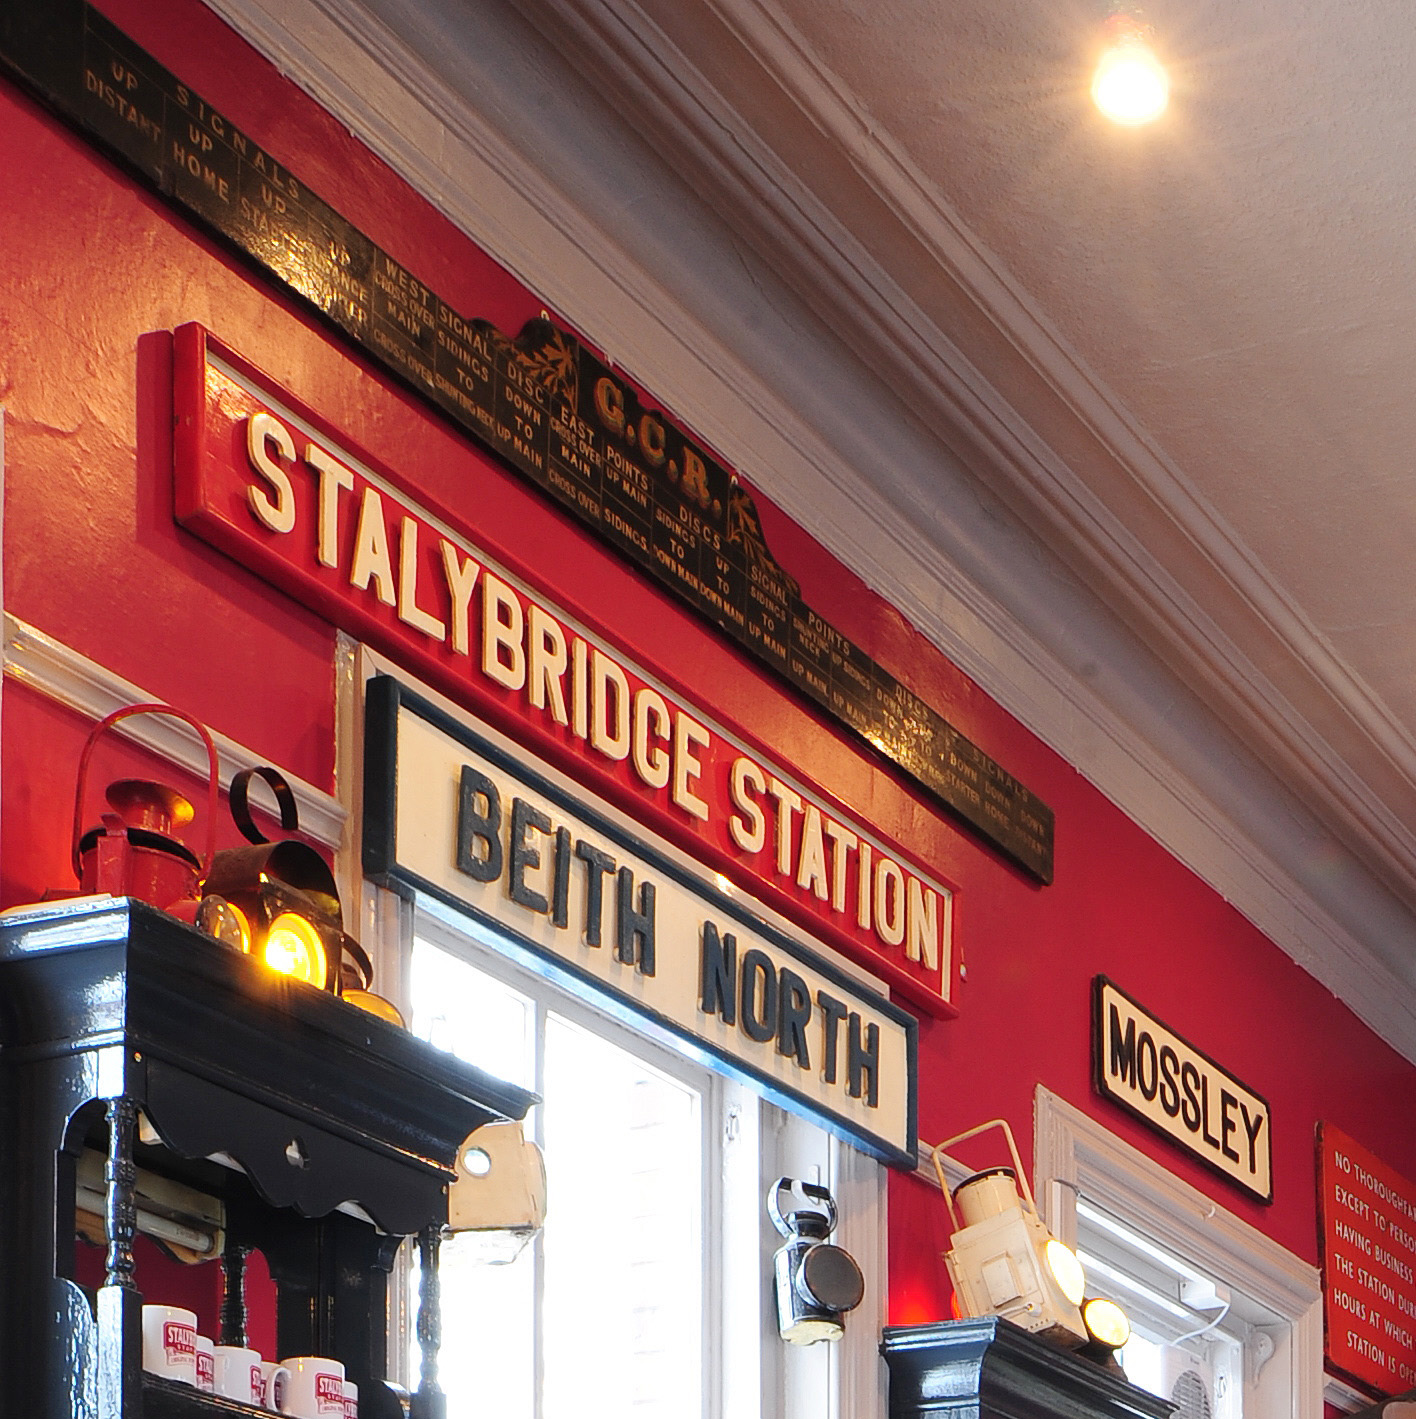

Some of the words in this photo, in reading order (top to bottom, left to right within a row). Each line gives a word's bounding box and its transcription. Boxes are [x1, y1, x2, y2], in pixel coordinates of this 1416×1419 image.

[111, 61, 139, 91] UP
[84, 68, 162, 143] DISTANT
[188, 123, 213, 152] UP
[173, 141, 230, 204] HOME
[261, 184, 287, 214] UP
[385, 258, 430, 306] WEST
[387, 301, 421, 339] MAIN
[439, 305, 493, 362] SIGNAL
[437, 330, 489, 383] SIDINGS
[456, 367, 474, 391] TO
[507, 361, 545, 405] DISC
[505, 384, 541, 427] DOWN
[560, 404, 595, 445] EAST
[497, 421, 512, 442] UP
[513, 435, 542, 469] MAIN
[514, 415, 533, 441] TO
[561, 445, 591, 479] MAIN
[606, 445, 649, 492] POINTS
[605, 467, 620, 484] UP
[622, 477, 648, 509] MAIN
[655, 507, 697, 549] SIDINGS
[669, 537, 685, 560] TO
[679, 504, 721, 551] DISCS
[715, 556, 730, 575] UP
[716, 575, 730, 595] TO
[751, 564, 788, 607] SIGNAL
[750, 585, 787, 623] SIDINGS
[761, 612, 775, 632] TO
[748, 621, 761, 638] UP
[762, 630, 786, 660] MAIN
[808, 611, 850, 655] POINTS
[245, 410, 711, 825] STALYBRIDGE
[728, 756, 940, 975] STATION
[950, 752, 978, 782] DOWN
[455, 763, 657, 978] BEITH
[699, 919, 881, 1109] NORTH
[1108, 1002, 1264, 1175] MOSSLEY
[1334, 1150, 1351, 1175] NO
[1334, 1184, 1370, 1222] EXCEPT
[1373, 1211, 1386, 1232] TO
[1334, 1218, 1372, 1256] HAVING
[1374, 1244, 1414, 1286] BUSINESS
[1333, 1253, 1354, 1280] THE
[1357, 1267, 1396, 1305] STATION
[1333, 1287, 1367, 1321] HOURS
[1369, 1308, 1381, 1329] AT
[1383, 1318, 1414, 1353] WHICH
[1346, 1329, 1386, 1368] STATION
[1387, 1355, 1396, 1374] IS
